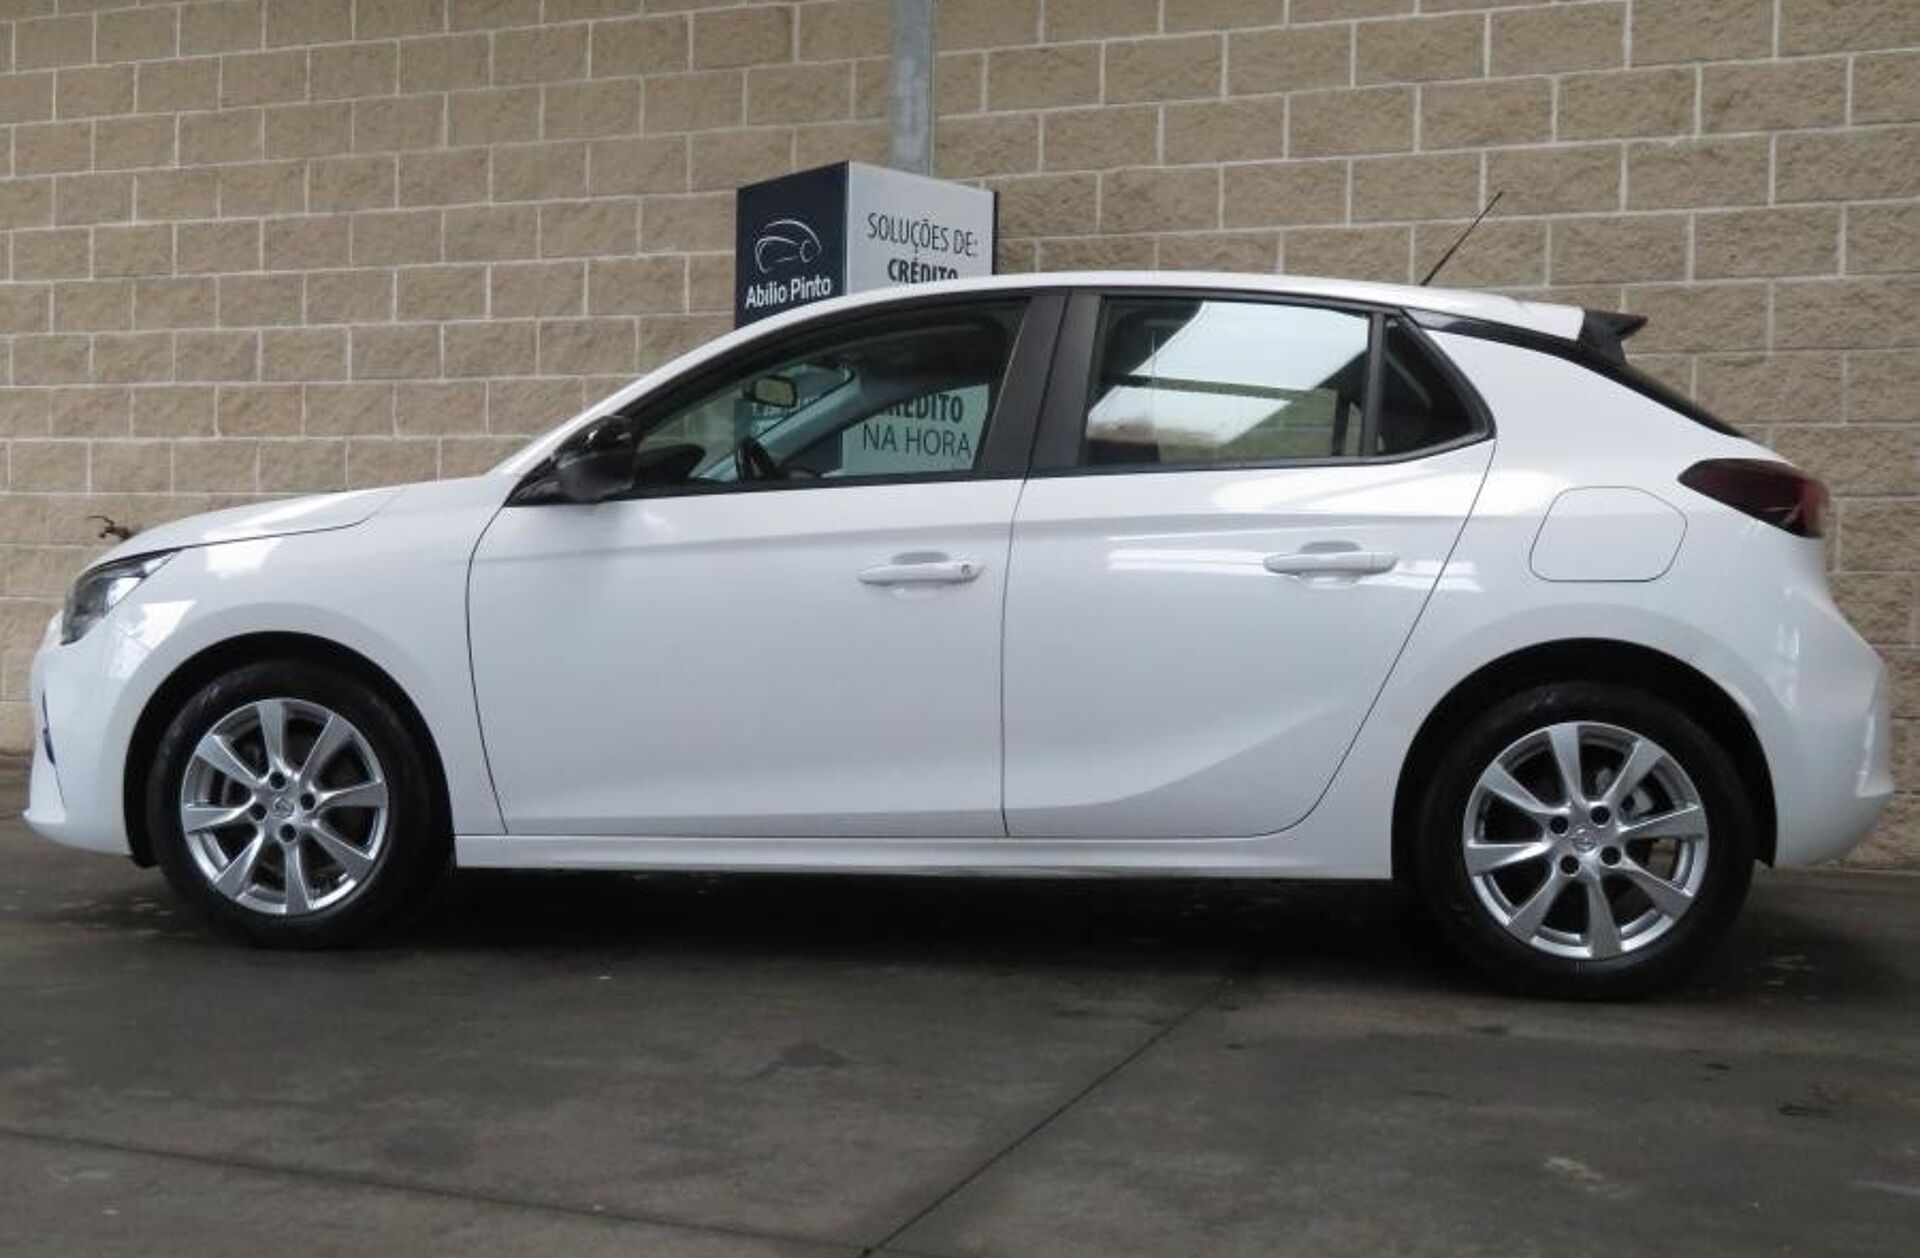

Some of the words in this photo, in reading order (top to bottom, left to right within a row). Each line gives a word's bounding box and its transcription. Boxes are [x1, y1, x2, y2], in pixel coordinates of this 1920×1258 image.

[867, 212, 949, 254] SOLUÇÕES
[953, 229, 978, 257] DE:
[791, 274, 831, 300] Pinto
[863, 423, 897, 452] NA
[905, 426, 971, 459] HORA
